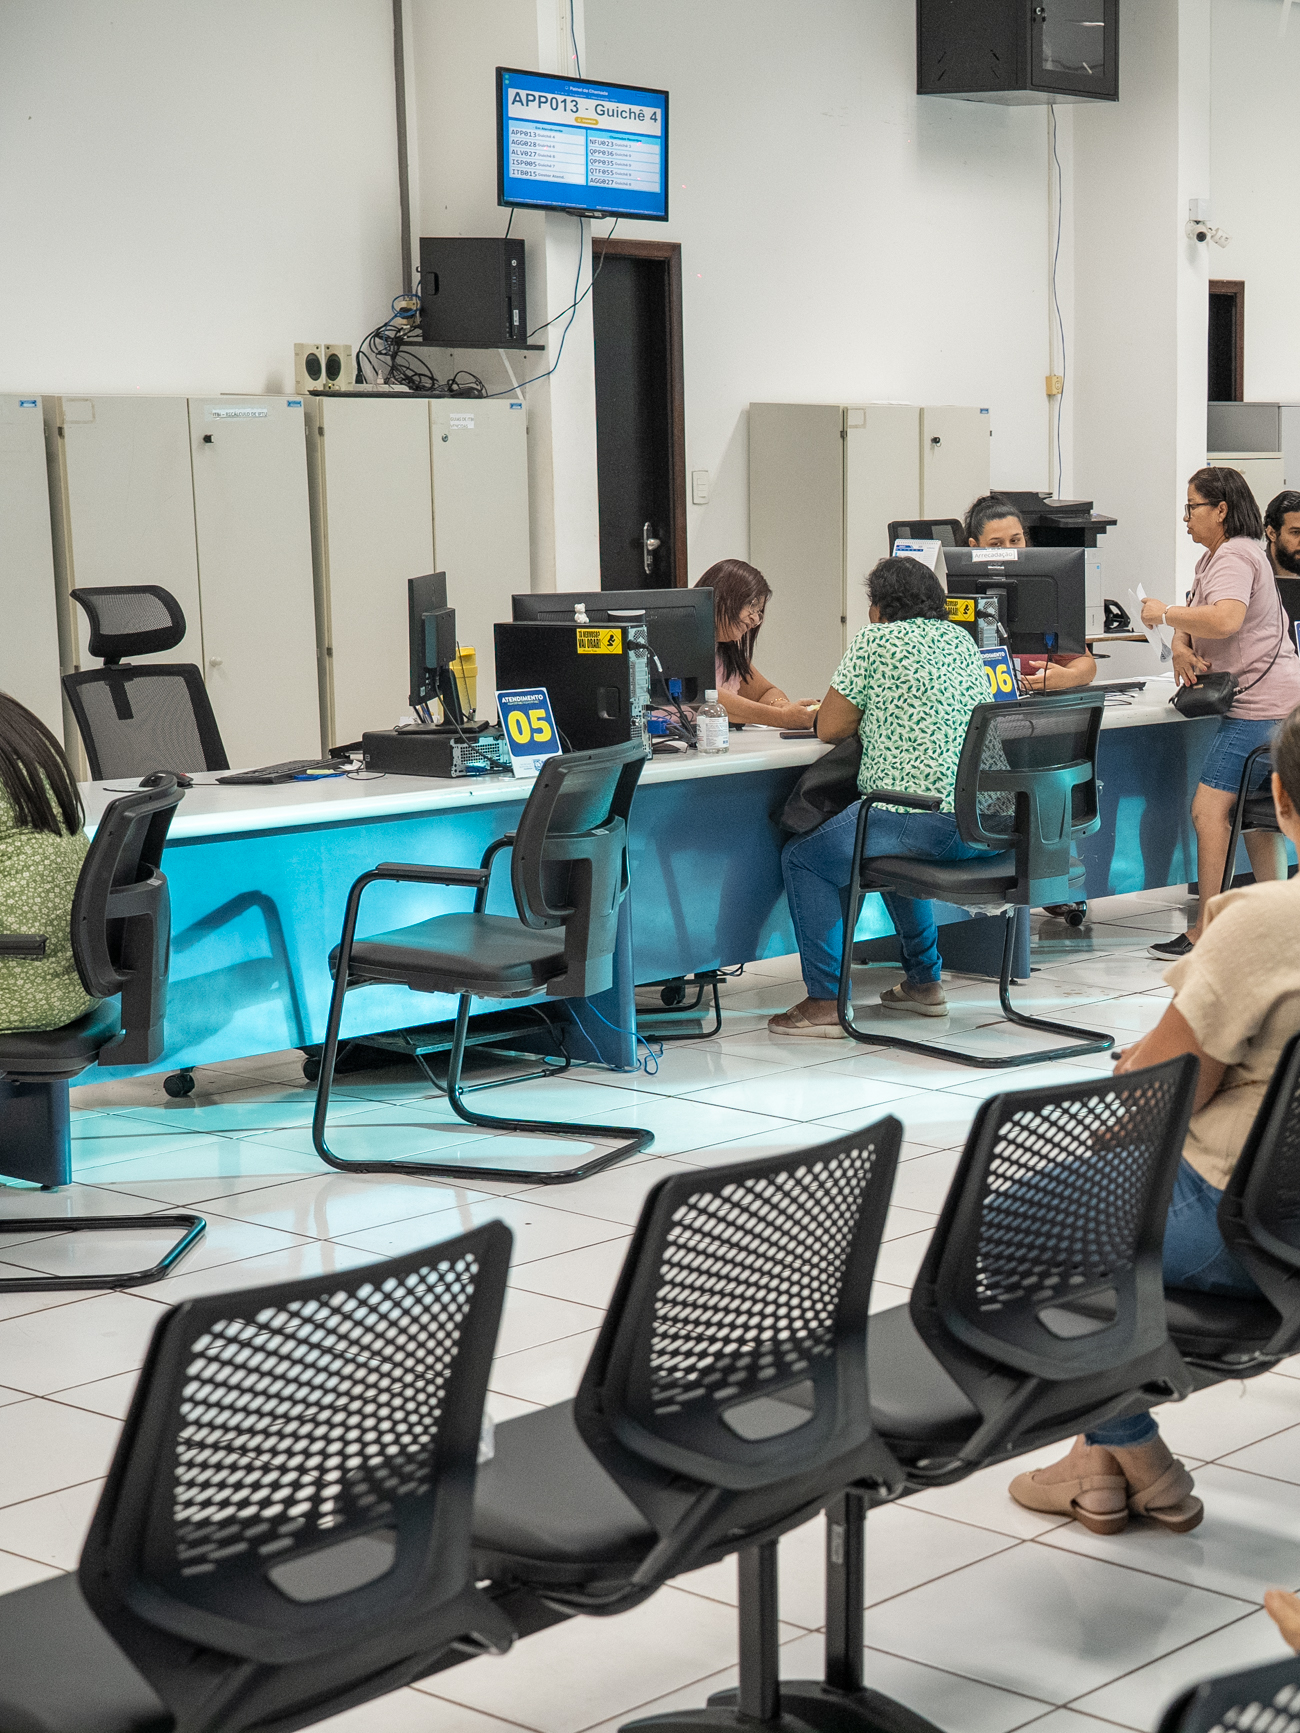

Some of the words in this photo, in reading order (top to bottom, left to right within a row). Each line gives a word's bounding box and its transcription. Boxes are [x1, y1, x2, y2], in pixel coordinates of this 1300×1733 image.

[512, 92, 579, 113] APP013
[594, 104, 645, 121] Guichê
[650, 111, 658, 123] 4
[511, 129, 537, 137] APP013
[511, 139, 537, 147] AGG028
[590, 139, 614, 147] NFU023
[511, 149, 537, 157] ALV027
[590, 149, 614, 157] QPP036
[512, 159, 537, 167] ISP005
[590, 158, 614, 166] QPP035
[590, 168, 614, 176] QTF055
[984, 664, 1012, 694] 06
[502, 694, 544, 703] ATENDIMENTO
[507, 709, 552, 744] 05
